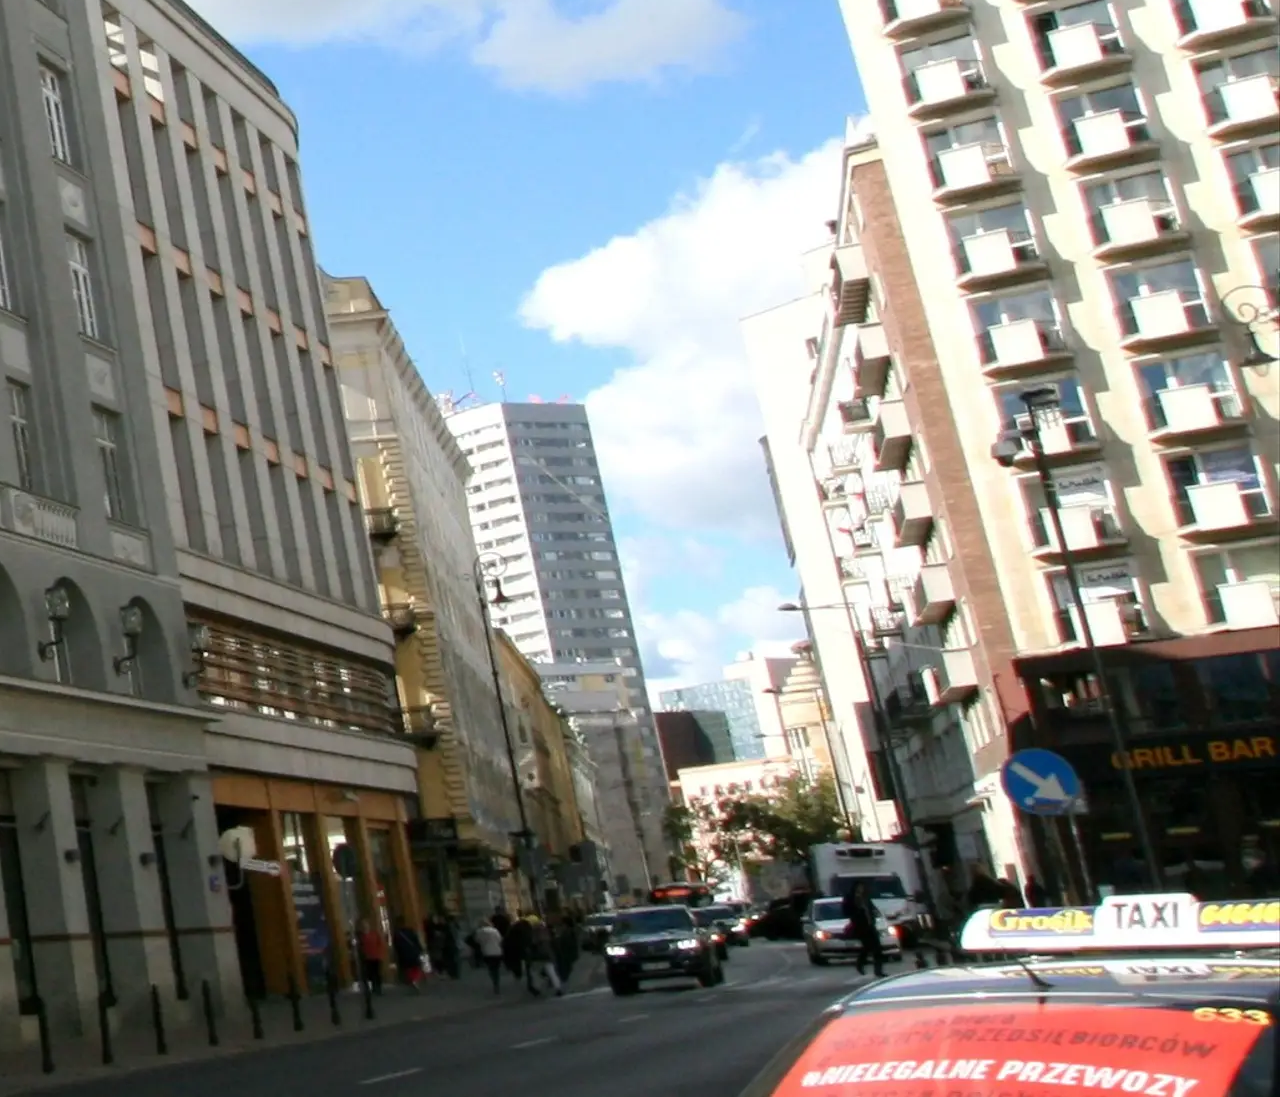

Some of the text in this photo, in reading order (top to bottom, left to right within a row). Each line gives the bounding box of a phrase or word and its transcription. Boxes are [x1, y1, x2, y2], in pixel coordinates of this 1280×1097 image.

[1207, 736, 1277, 762] BAR
[1111, 903, 1180, 929] TAXI
[1193, 1006, 1272, 1026] 633
[996, 1060, 1200, 1097] PRZEWOZY
